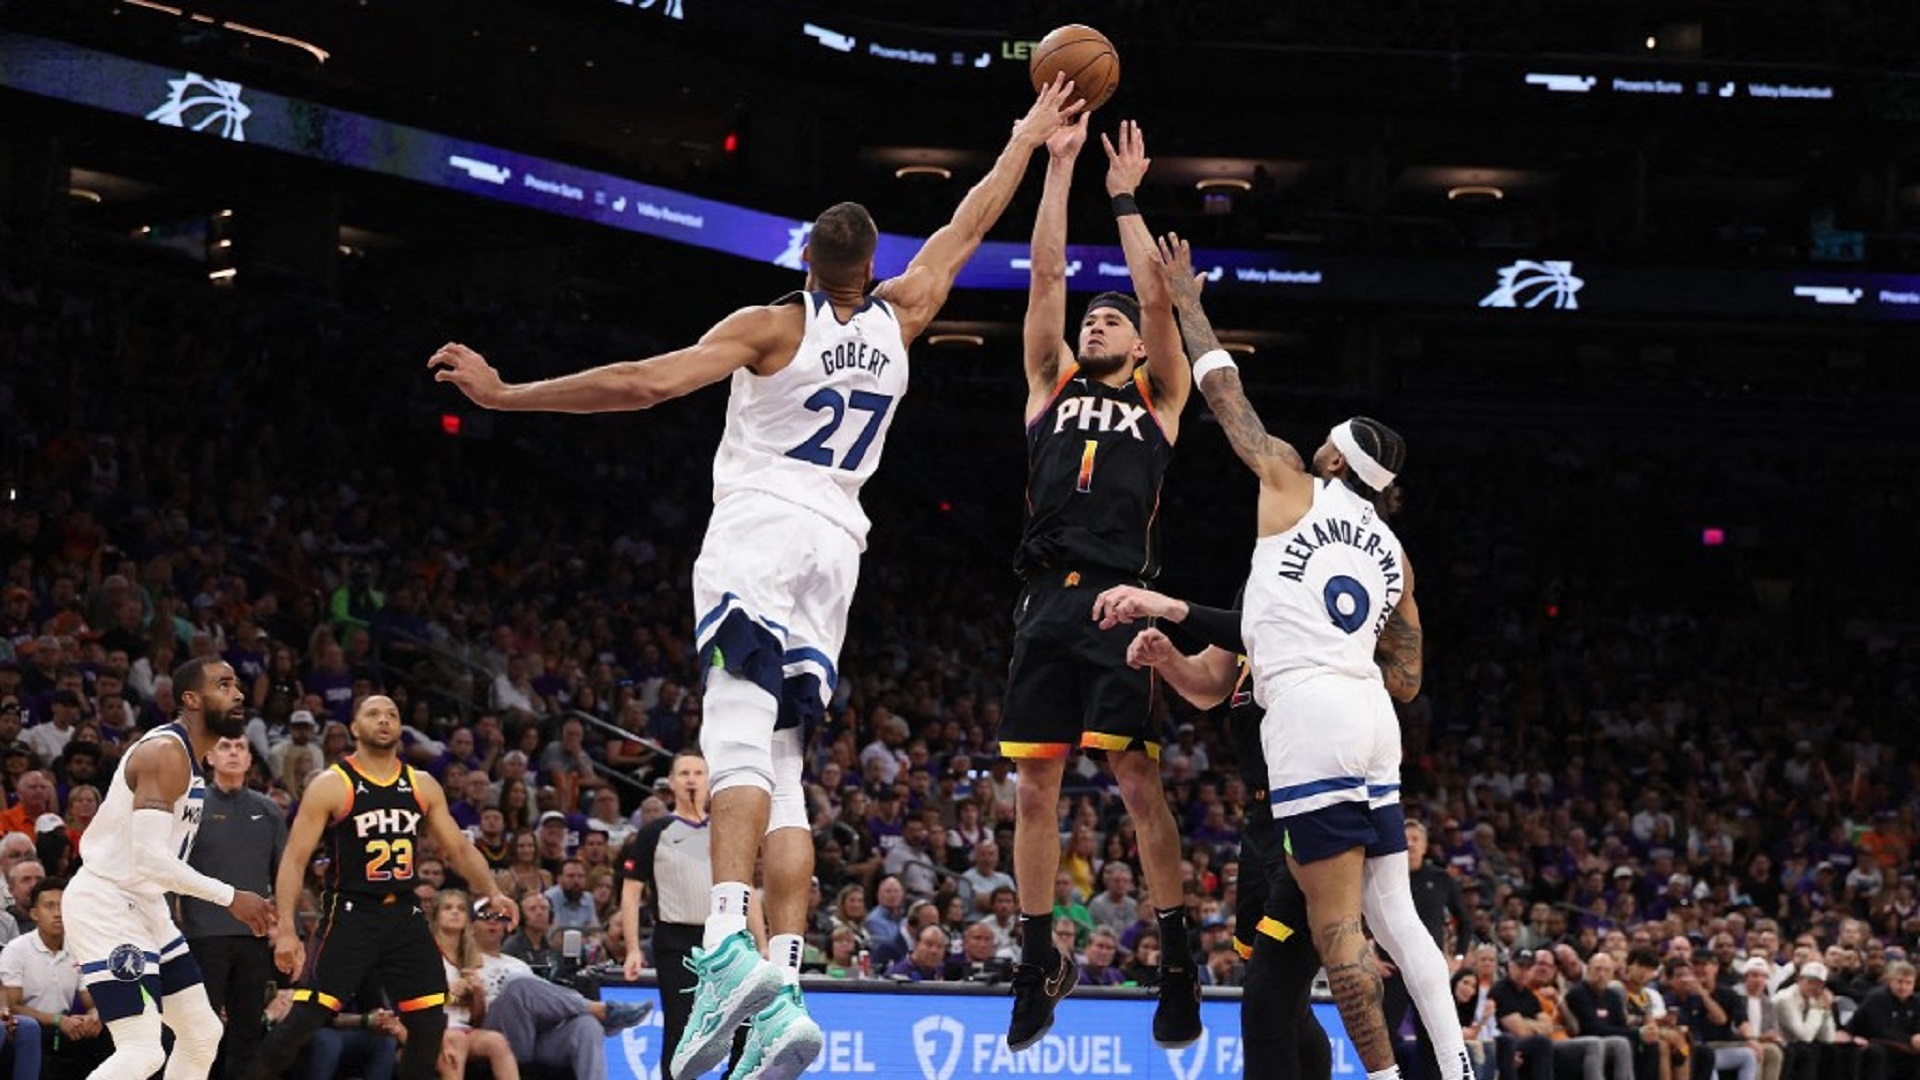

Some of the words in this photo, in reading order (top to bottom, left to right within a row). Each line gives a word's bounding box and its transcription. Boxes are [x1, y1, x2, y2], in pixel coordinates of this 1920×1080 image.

[821, 342, 890, 377] GOBERT
[784, 387, 893, 471] 27
[1053, 396, 1146, 441] PHX
[1076, 439, 1098, 493] 1
[1323, 574, 1370, 635] 0
[353, 808, 421, 838] PHX
[365, 838, 414, 881] 23
[972, 1033, 1132, 1075] FANDUEL
